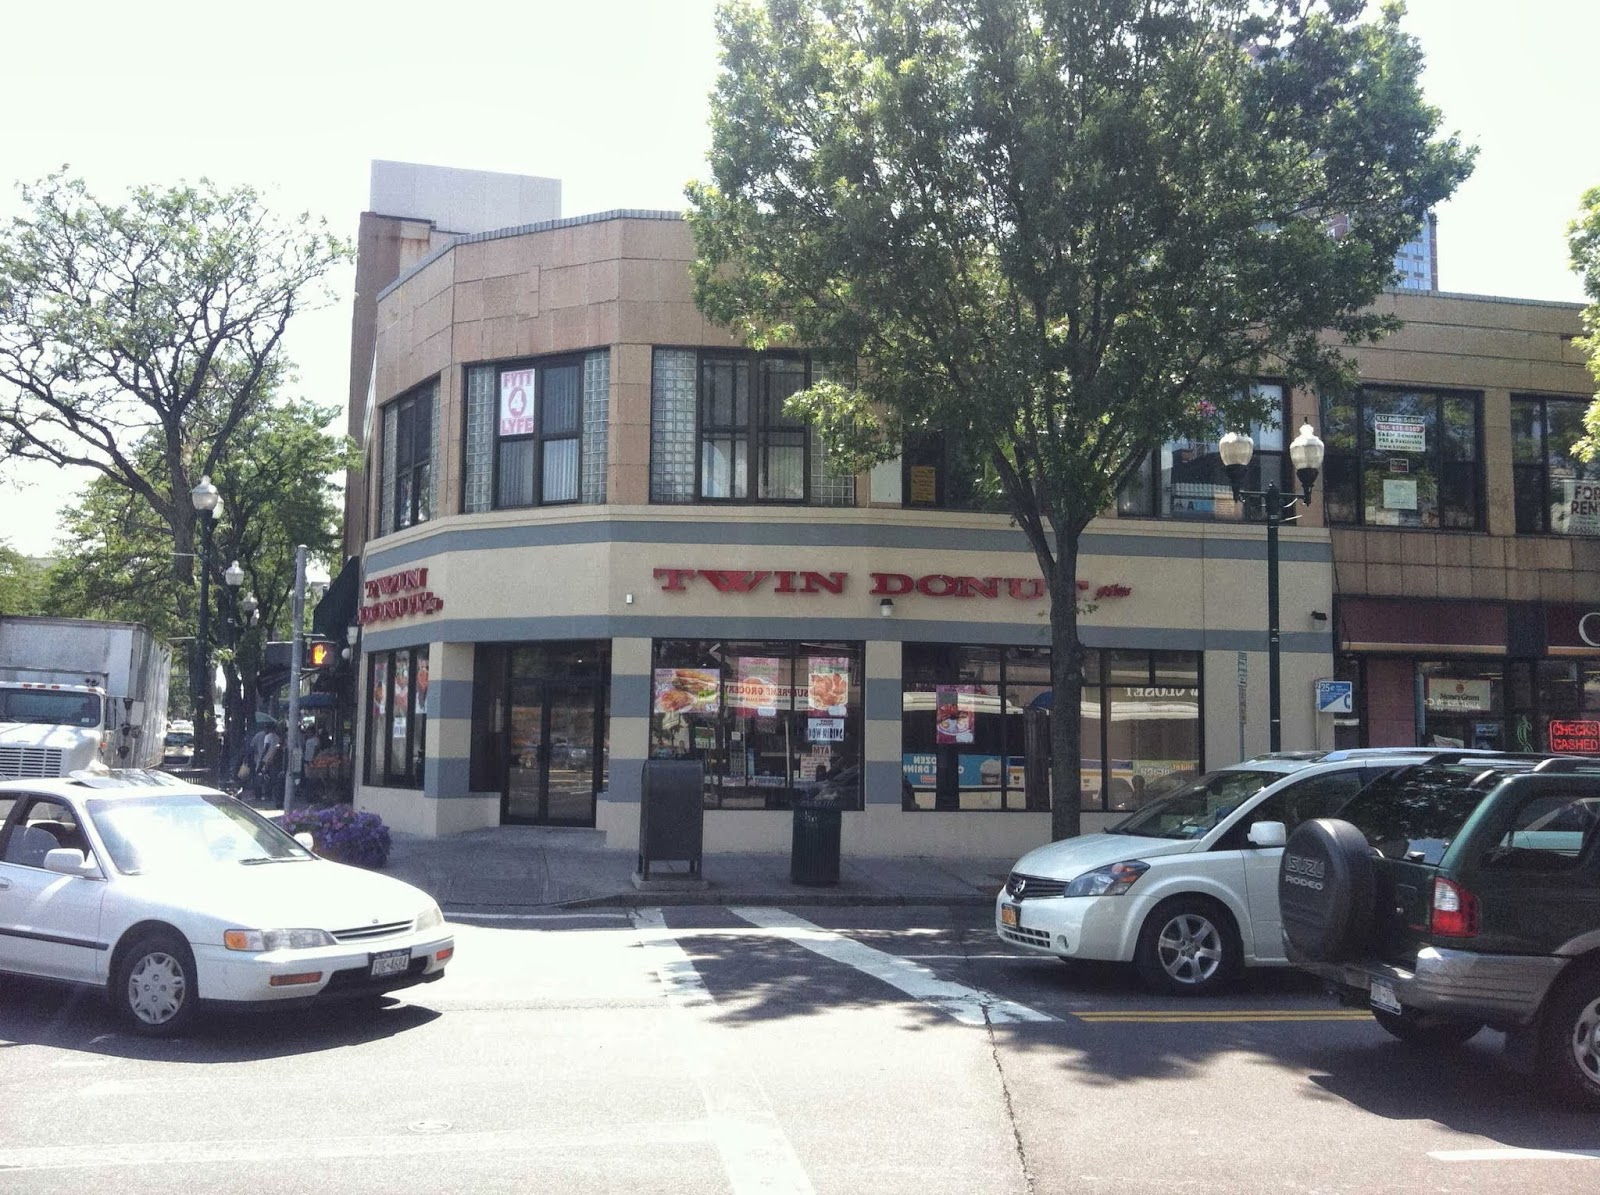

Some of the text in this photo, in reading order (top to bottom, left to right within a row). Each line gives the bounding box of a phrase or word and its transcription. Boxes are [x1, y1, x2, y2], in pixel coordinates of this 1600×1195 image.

[1571, 500, 1600, 516] REN
[364, 568, 429, 598] TWIN
[653, 568, 849, 594] TWIN
[1552, 722, 1599, 736] CHECKS
[1553, 738, 1599, 751] CASHED
[1285, 853, 1325, 879] ISUZU
[1285, 875, 1323, 891] RODEO
